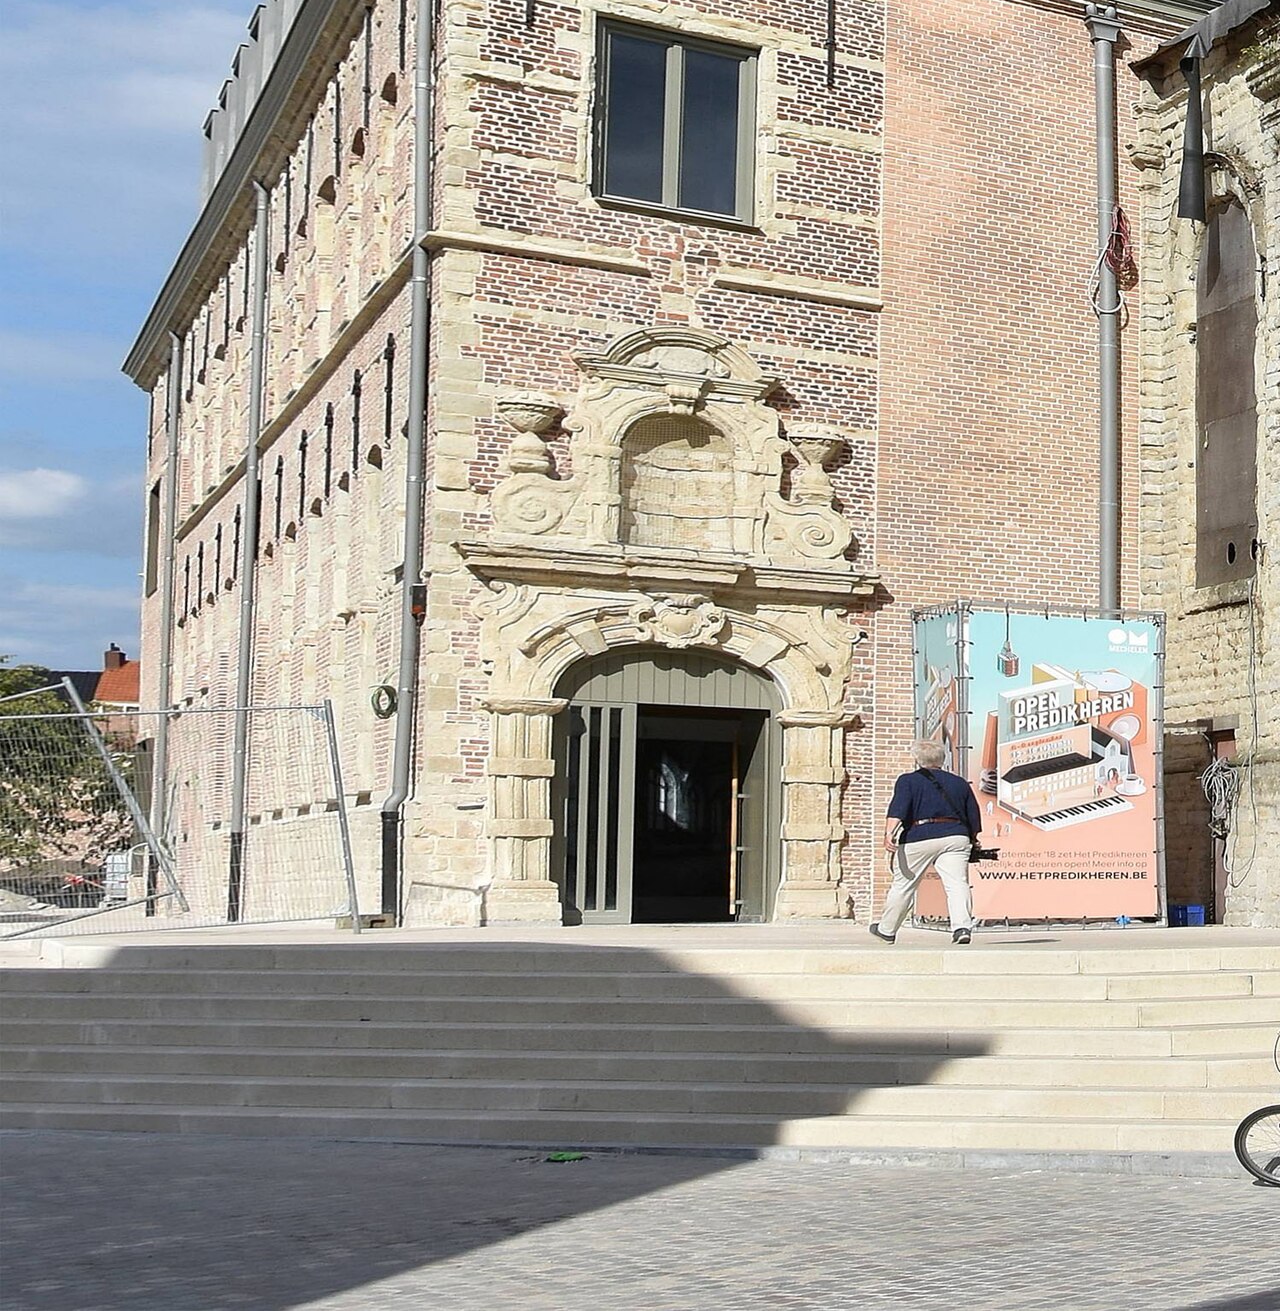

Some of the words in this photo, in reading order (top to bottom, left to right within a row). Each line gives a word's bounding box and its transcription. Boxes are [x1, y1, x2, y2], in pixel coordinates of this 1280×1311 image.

[1013, 691, 1060, 717] OPEN
[1013, 691, 1135, 736] PREDIKHEREN
[998, 850, 1042, 860] ptember
[1058, 850, 1073, 858] zet
[1074, 850, 1091, 858] Het
[1092, 850, 1148, 858] Predikheren
[1014, 860, 1028, 868] de
[1028, 860, 1063, 868] deuren
[1063, 860, 1091, 869] open!
[979, 871, 1148, 880] WWW.HETPREDIKHEREN.BE
